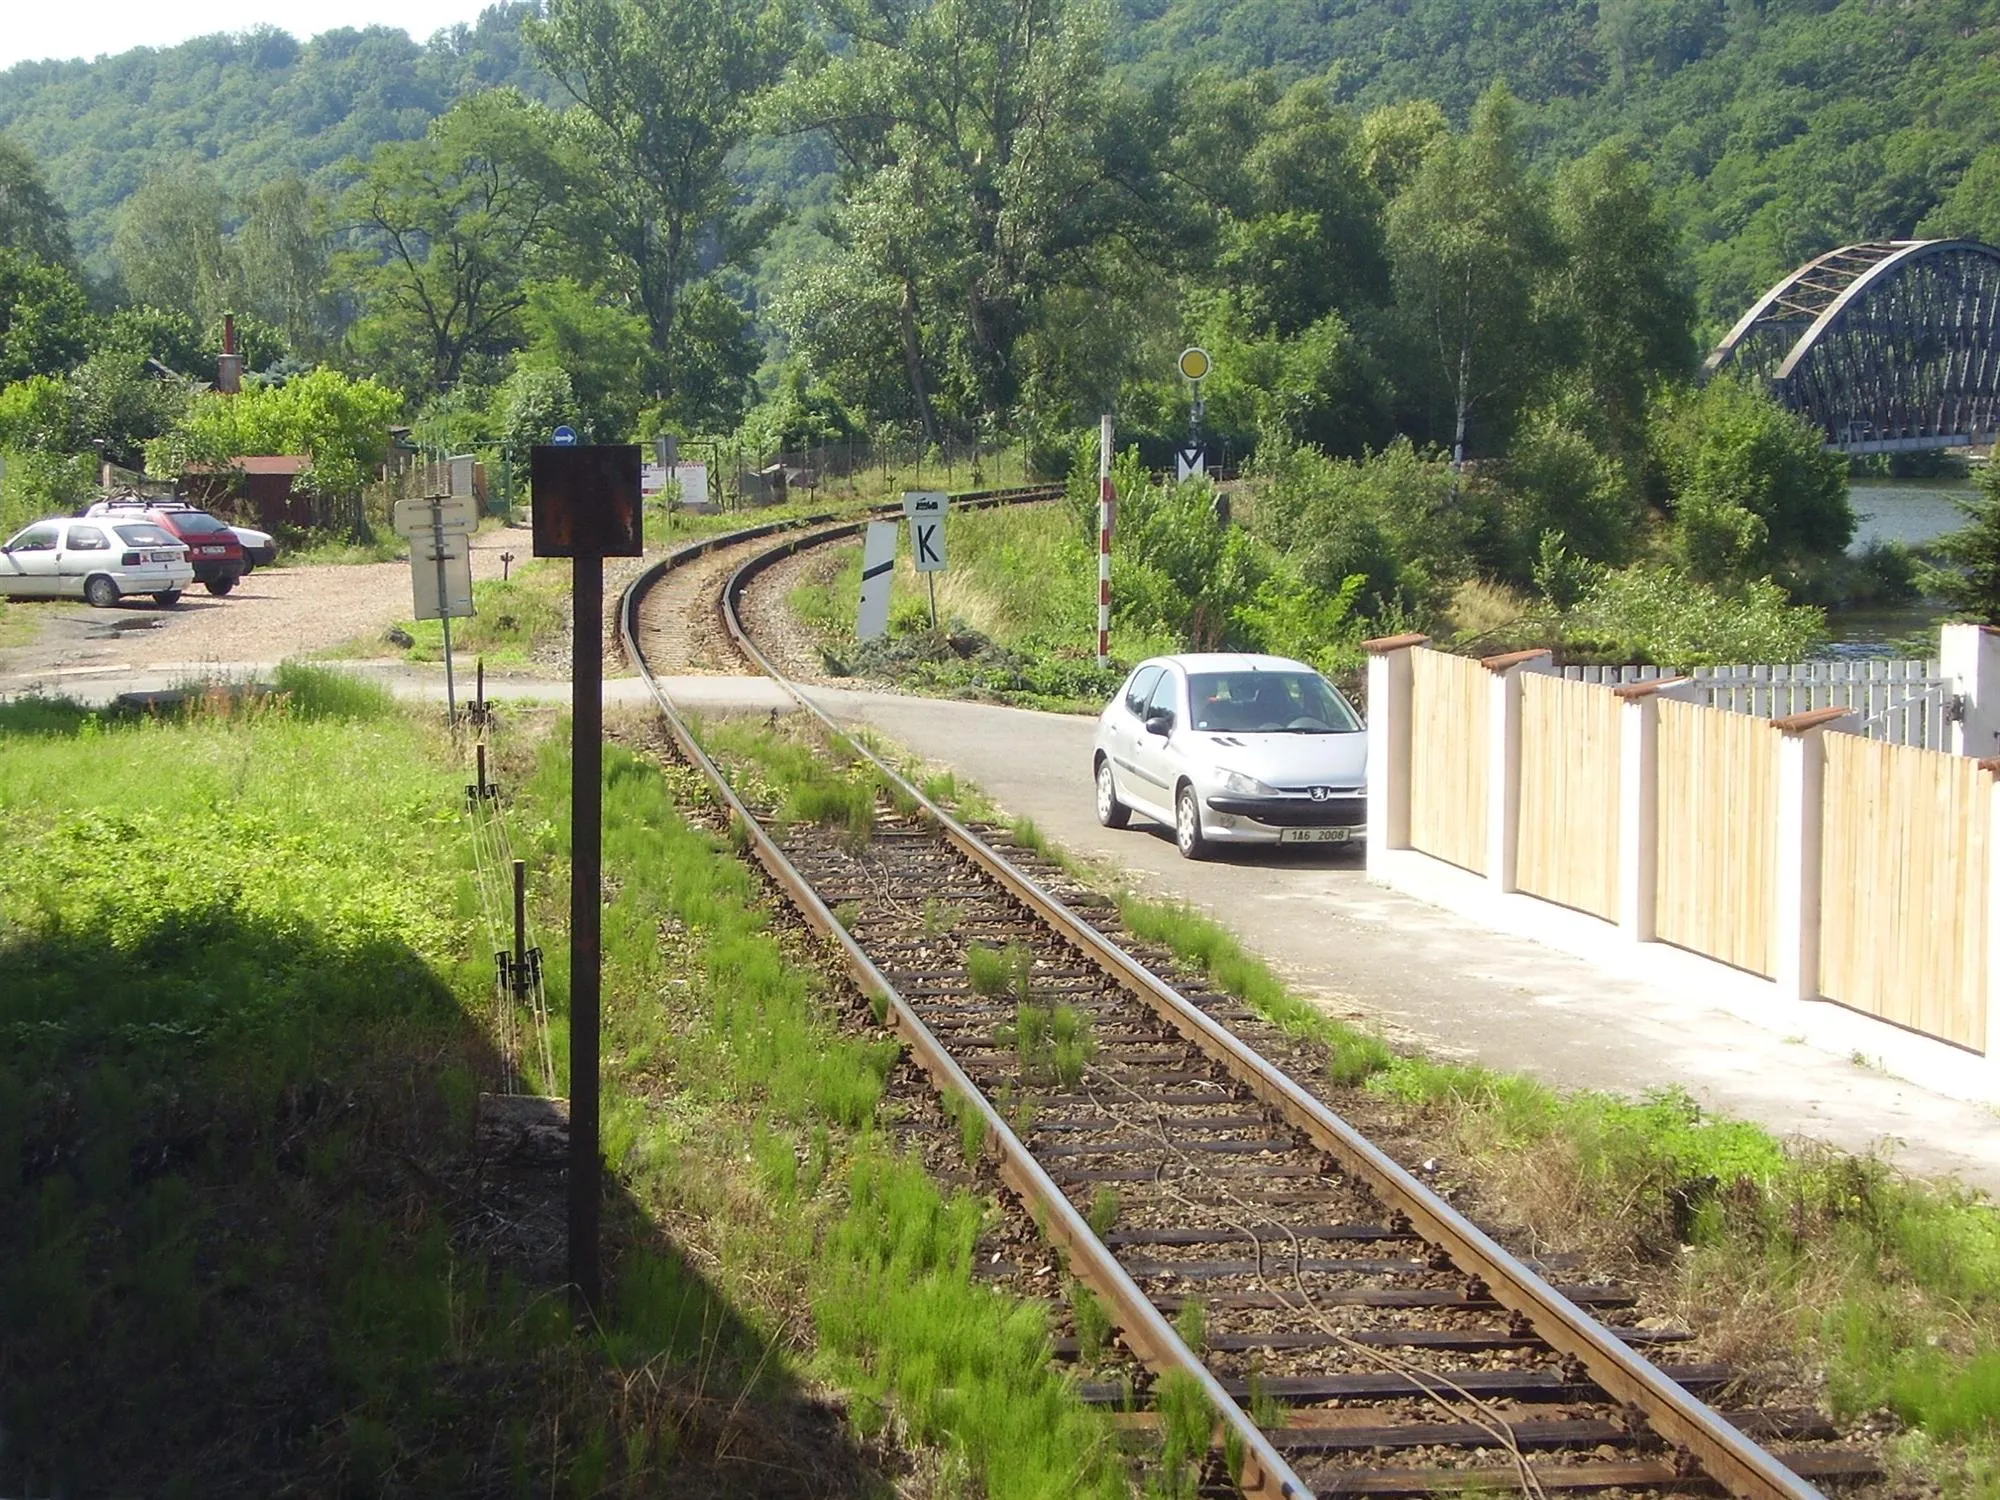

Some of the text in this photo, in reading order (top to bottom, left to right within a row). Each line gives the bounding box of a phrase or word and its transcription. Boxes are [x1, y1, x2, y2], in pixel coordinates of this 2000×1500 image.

[917, 524, 940, 563] K
[1292, 830, 1344, 840] 1A6 2008
